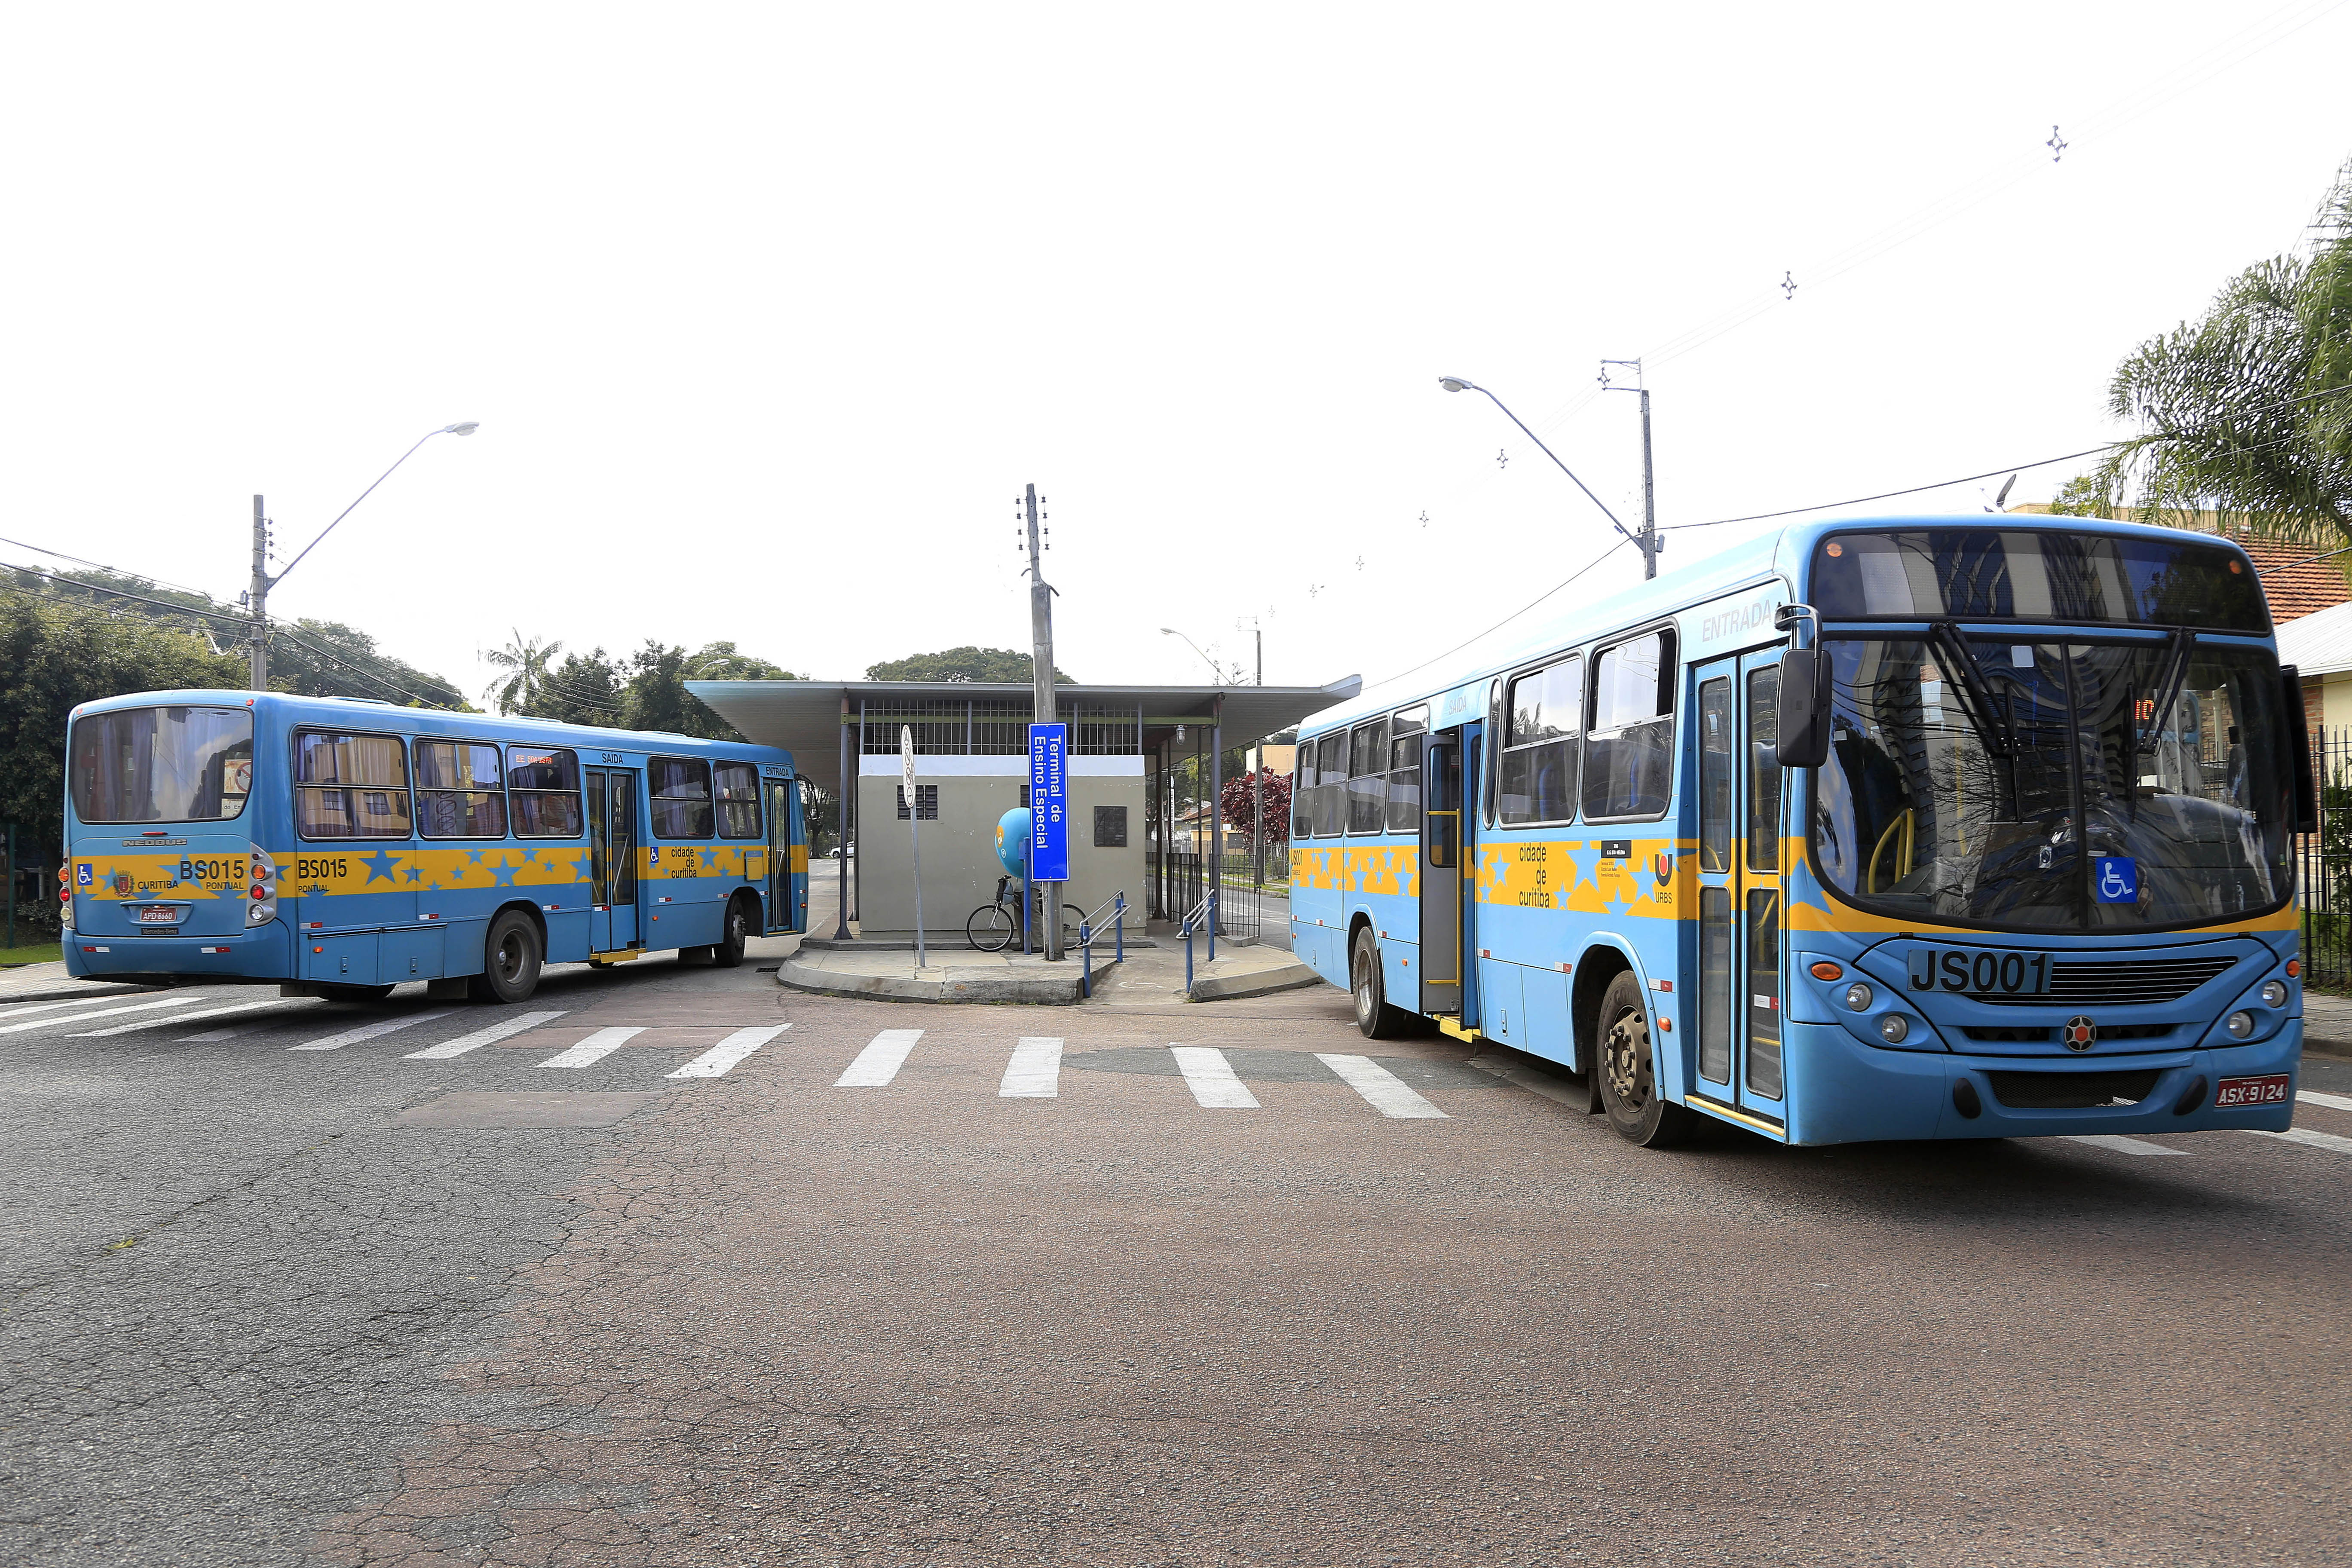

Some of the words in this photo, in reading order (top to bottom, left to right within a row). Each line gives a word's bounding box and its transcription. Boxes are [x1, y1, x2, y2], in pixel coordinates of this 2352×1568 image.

[1702, 599, 1772, 643] ENTRADA
[1449, 694, 1467, 715] SAÍDA
[602, 750, 623, 764] SAÍDA
[1035, 736, 1047, 784] Ensino
[1050, 735, 1063, 797] Terminal
[766, 766, 789, 777] ENTRADA
[1033, 788, 1048, 849] Especial
[1051, 804, 1063, 823] de
[122, 839, 187, 847] NEOBUS
[671, 846, 694, 857] cidade
[1519, 842, 1547, 862] cidade
[686, 858, 695, 867] de
[1292, 849, 1302, 866] JS001
[180, 860, 244, 880] BS015
[298, 859, 347, 879] BS015
[671, 868, 697, 879] curitiba
[1536, 864, 1547, 885] de
[138, 881, 179, 889] CURITIBA
[1519, 887, 1550, 908] curitiba
[1655, 891, 1672, 904] URBS
[1912, 950, 2046, 993] JS001
[2218, 1084, 2285, 1104] ASX-9124
